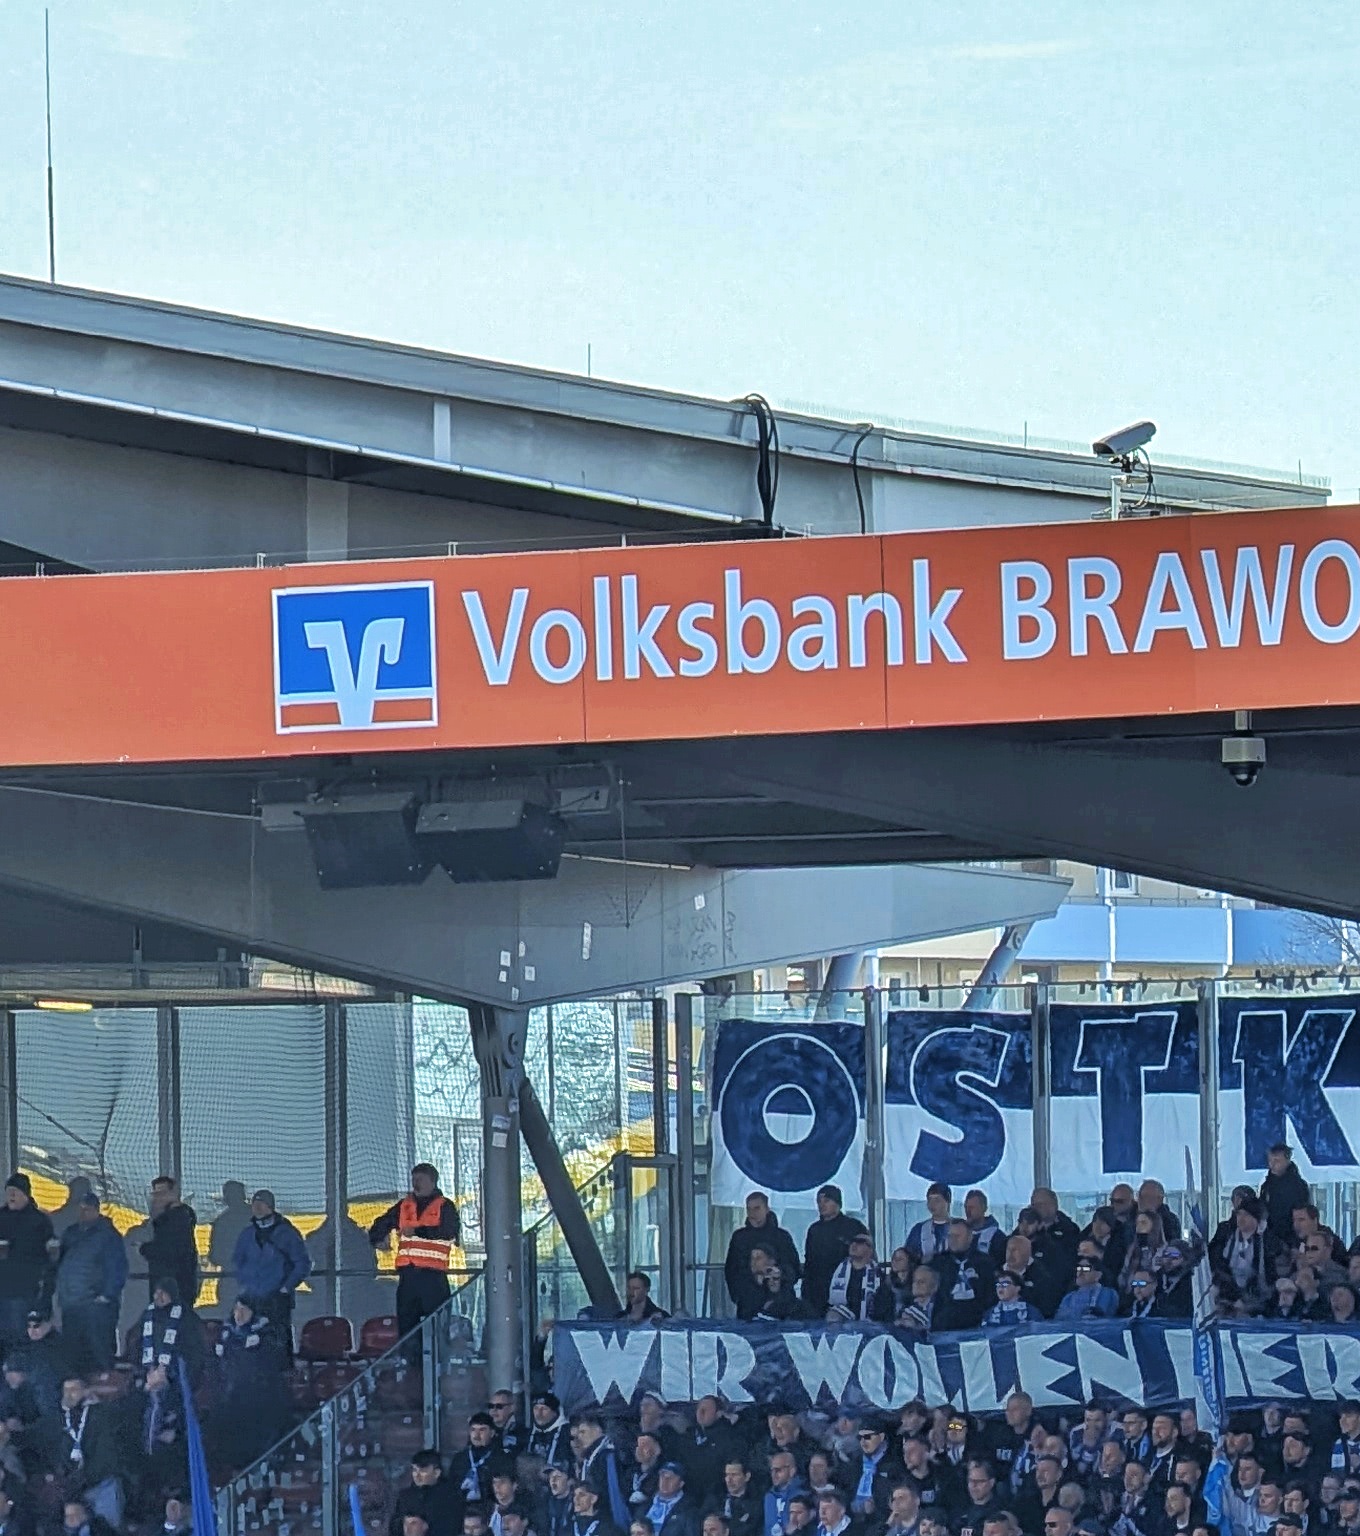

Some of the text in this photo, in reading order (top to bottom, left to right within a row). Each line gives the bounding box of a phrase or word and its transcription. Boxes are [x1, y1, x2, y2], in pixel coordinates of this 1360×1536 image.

[462, 559, 968, 688] Volksbank
[571, 1330, 756, 1404] WIR
[782, 1330, 1144, 1411] WOLLEN
